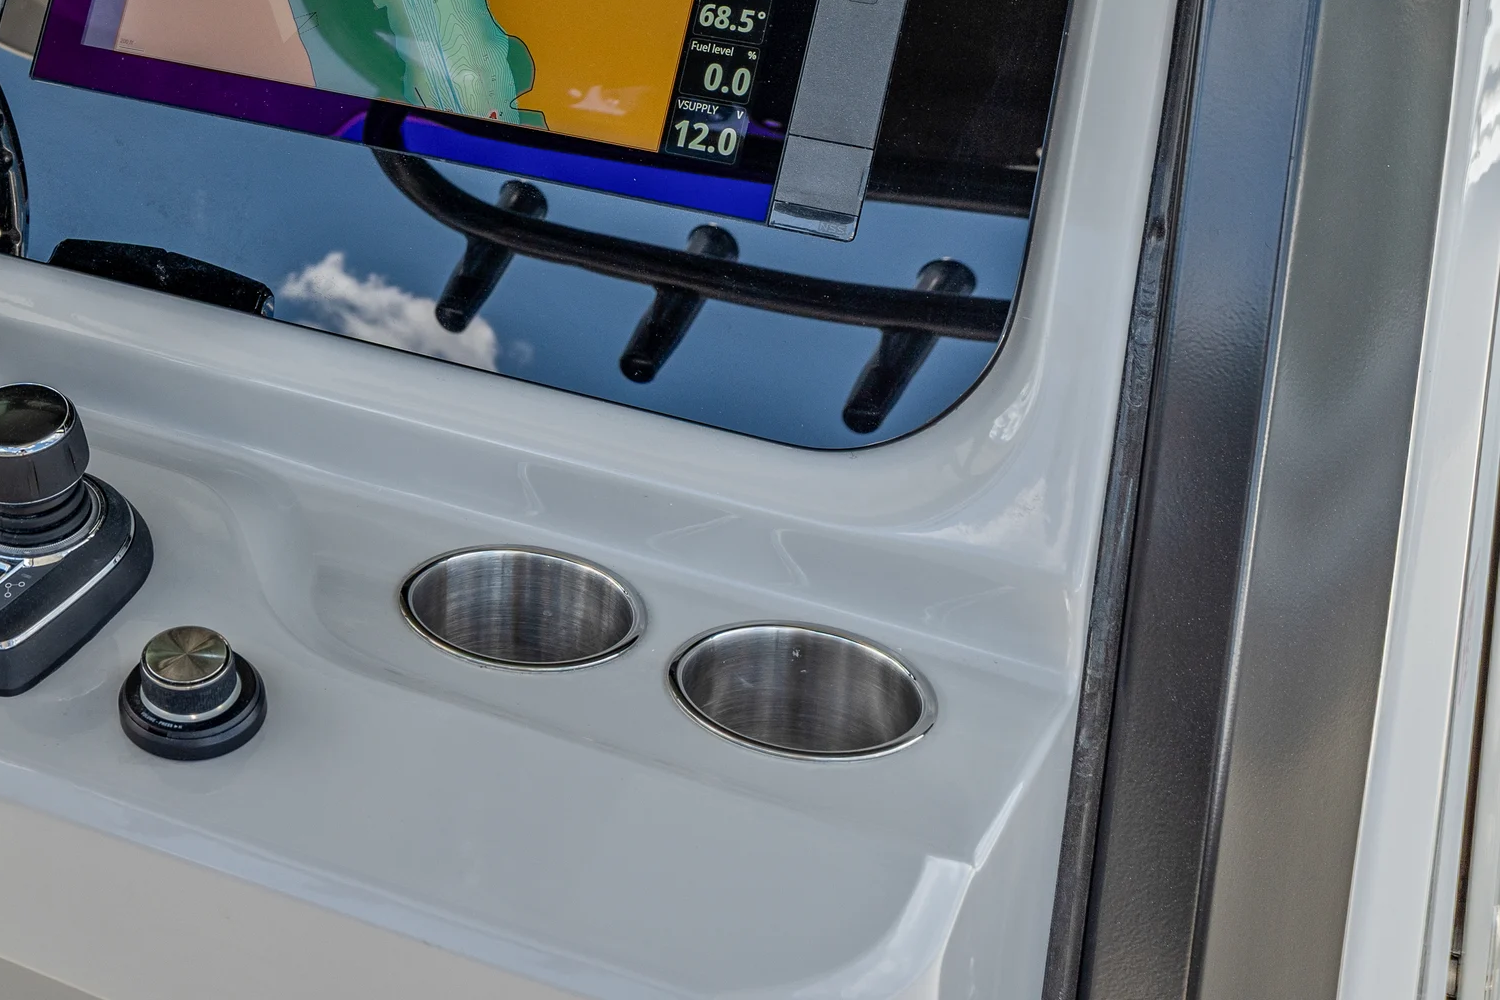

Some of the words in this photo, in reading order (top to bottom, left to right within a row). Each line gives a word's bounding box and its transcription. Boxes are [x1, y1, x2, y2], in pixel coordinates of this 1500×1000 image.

[699, 4, 766, 32] 68.5°
[691, 40, 710, 52] Fuel
[712, 44, 734, 56] level
[748, 51, 756, 60] %
[704, 63, 751, 96] 0.0
[678, 100, 719, 115] VSUPPLY
[736, 110, 744, 120] V
[675, 120, 737, 156] 12.0
[819, 222, 846, 234] NSS
